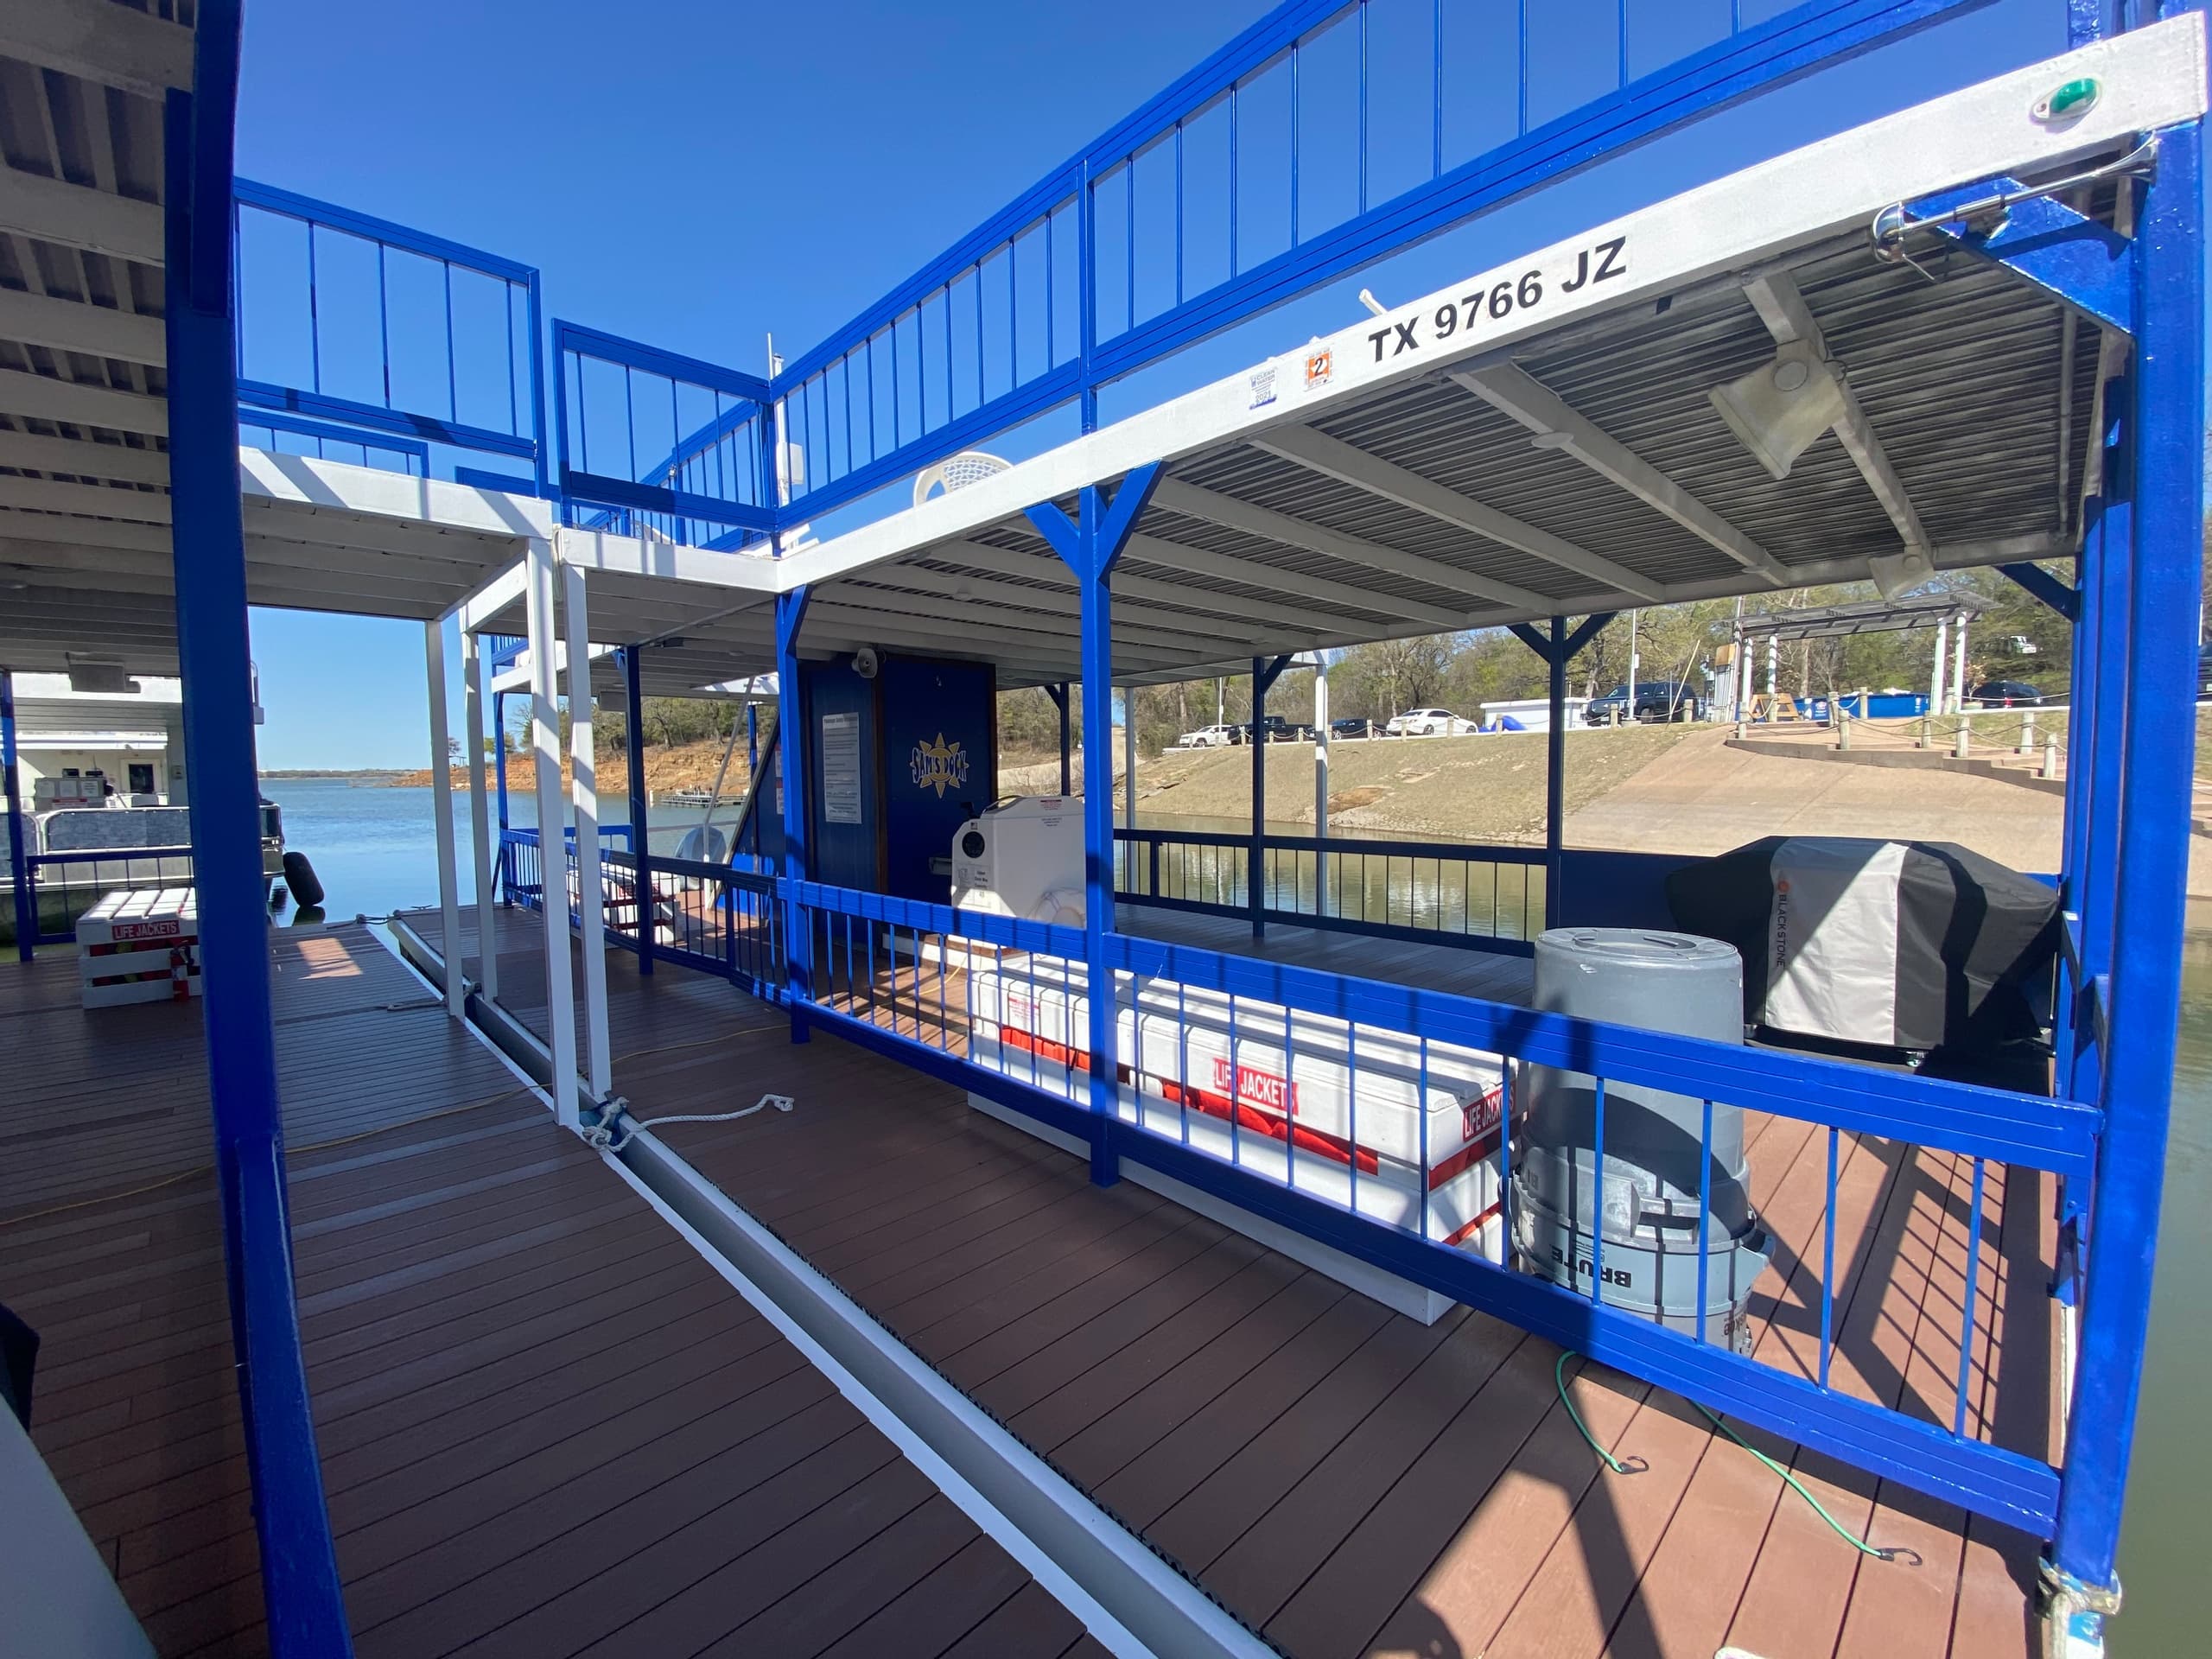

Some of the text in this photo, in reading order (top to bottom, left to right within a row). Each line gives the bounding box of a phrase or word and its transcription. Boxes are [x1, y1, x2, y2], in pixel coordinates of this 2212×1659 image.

[1368, 236, 1626, 363] TX 9766 JZ
[1314, 357, 1324, 377] 2
[943, 750, 967, 782] DOCK
[114, 921, 177, 938] LIFE JACKETS
[1777, 894, 1788, 967] BLACKSTONE
[1216, 1061, 1294, 1109] LIF JACKET
[1465, 1085, 1515, 1138] LIFE JACKS
[1550, 1244, 1631, 1288] BRUTE
